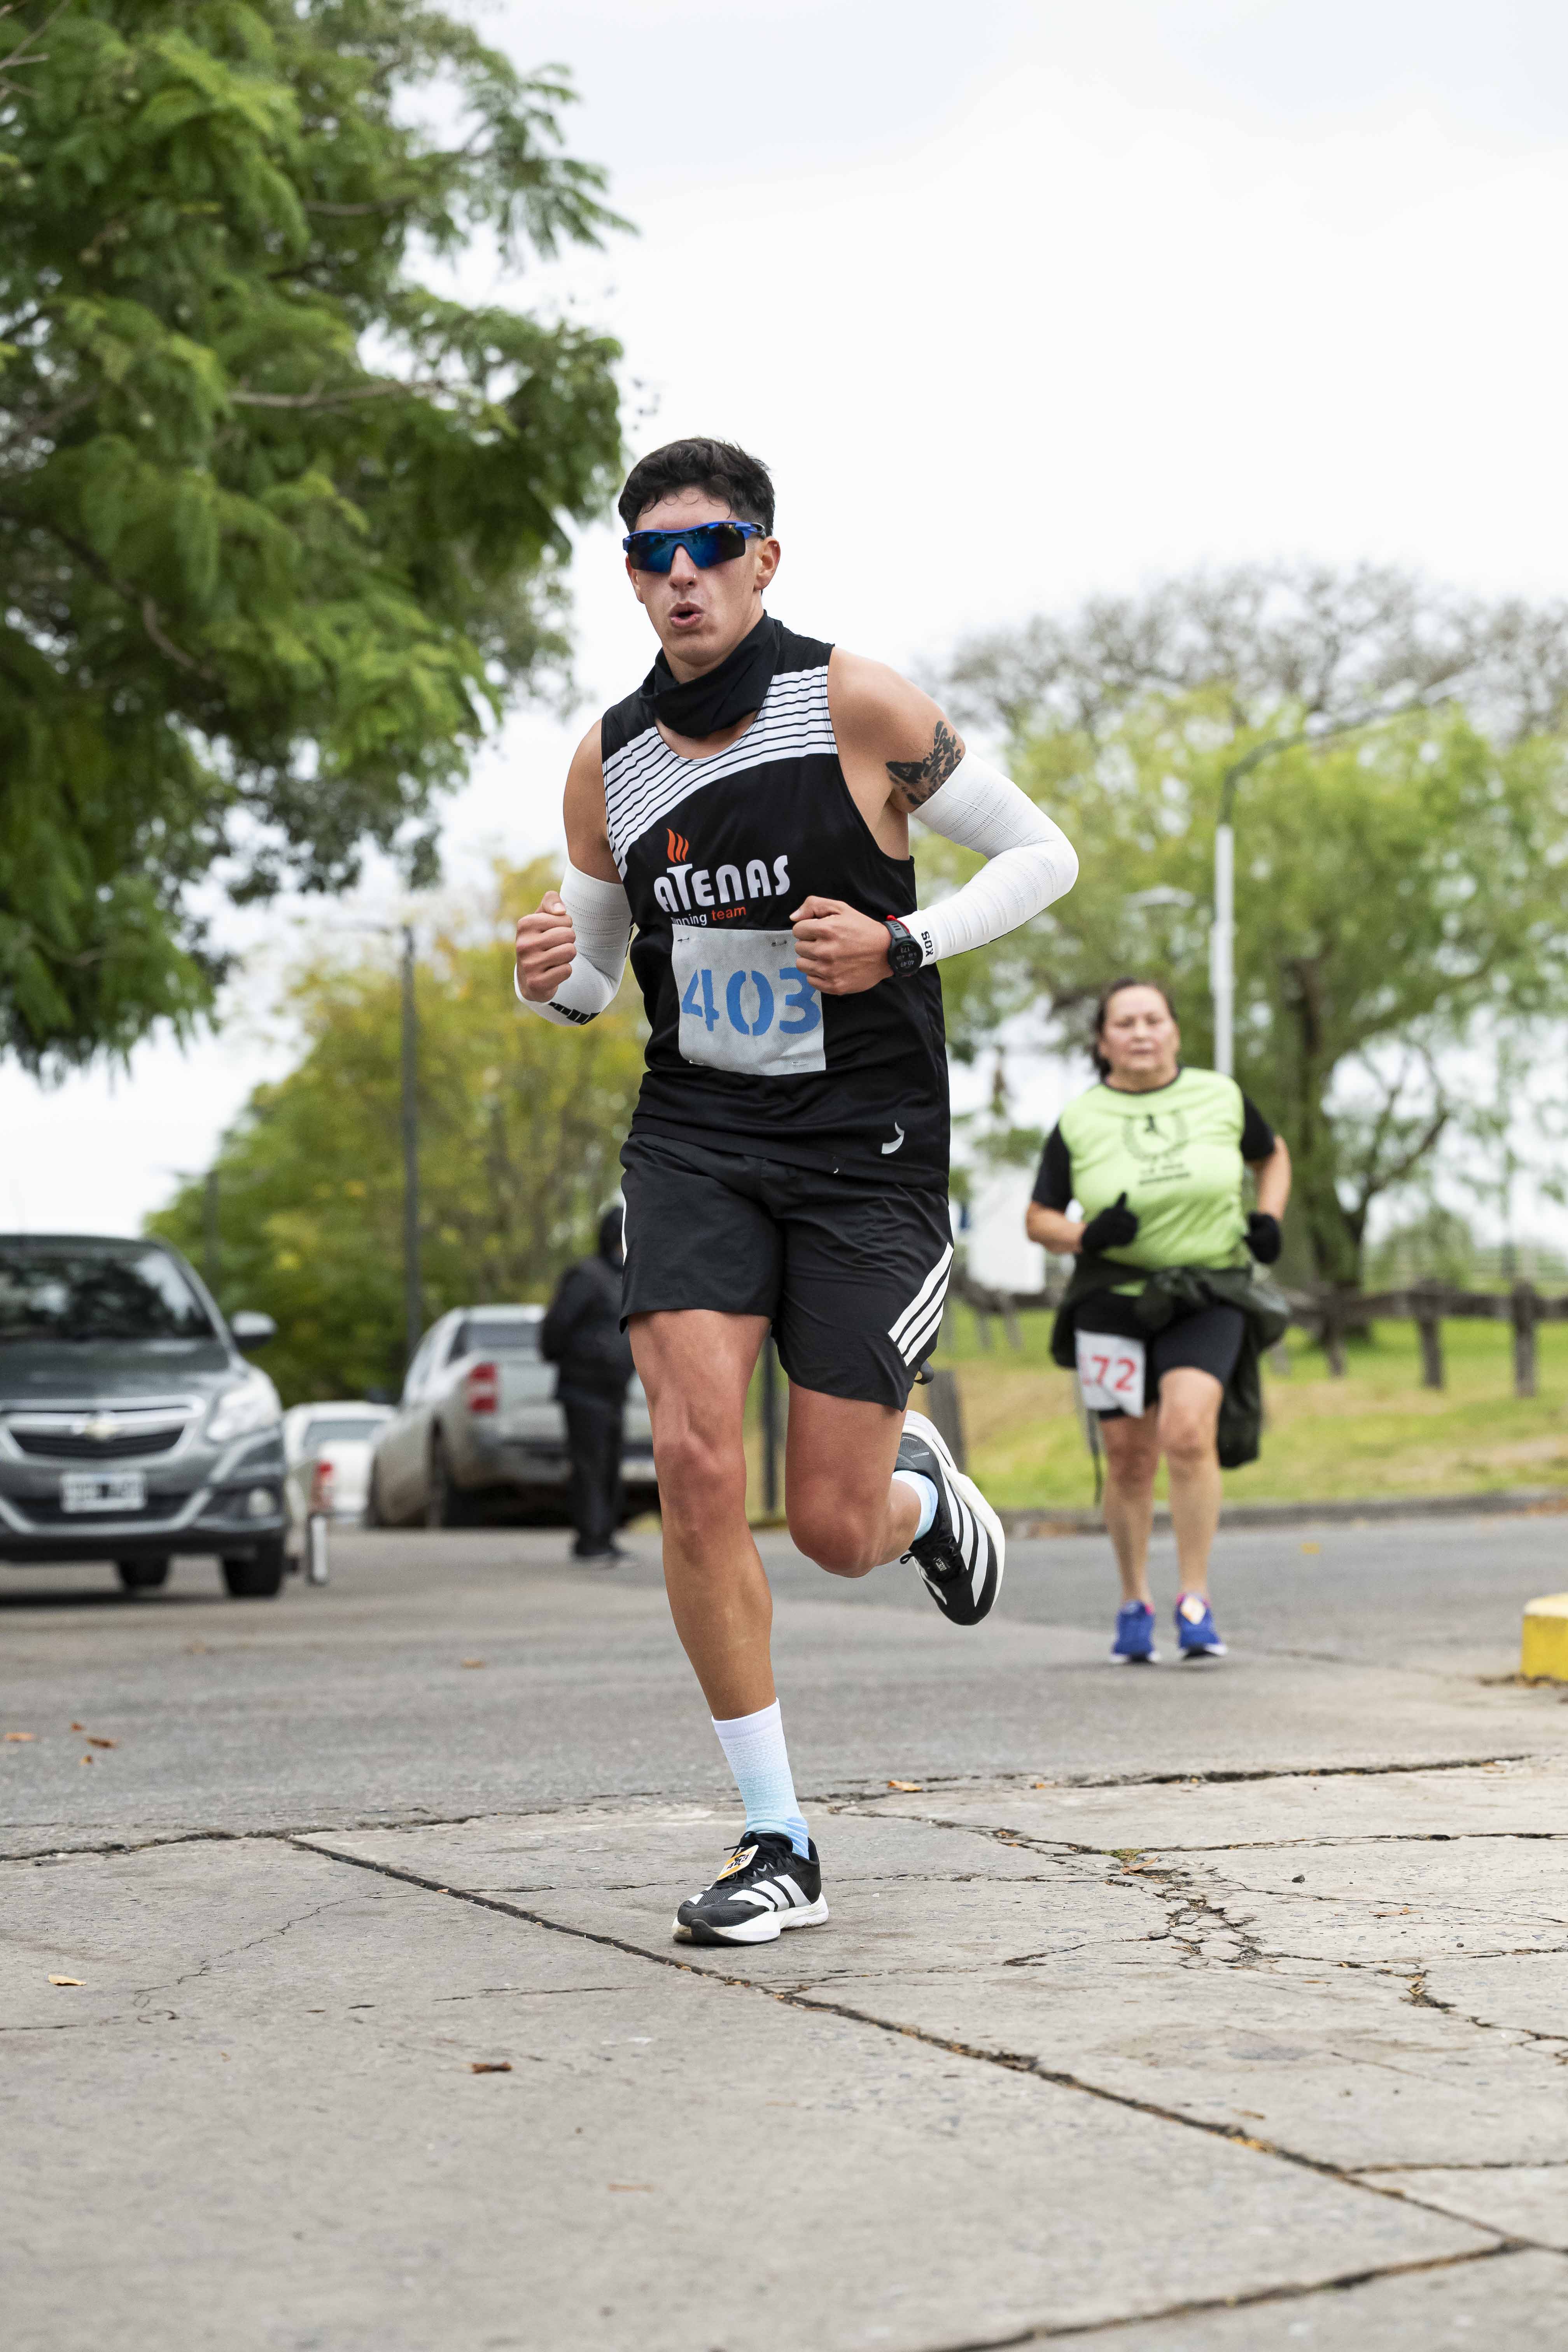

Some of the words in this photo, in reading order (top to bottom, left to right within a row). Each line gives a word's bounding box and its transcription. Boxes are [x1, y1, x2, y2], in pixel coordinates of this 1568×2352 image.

[711, 906, 747, 920] team
[921, 931, 933, 957] SOX
[681, 967, 821, 1036] 403
